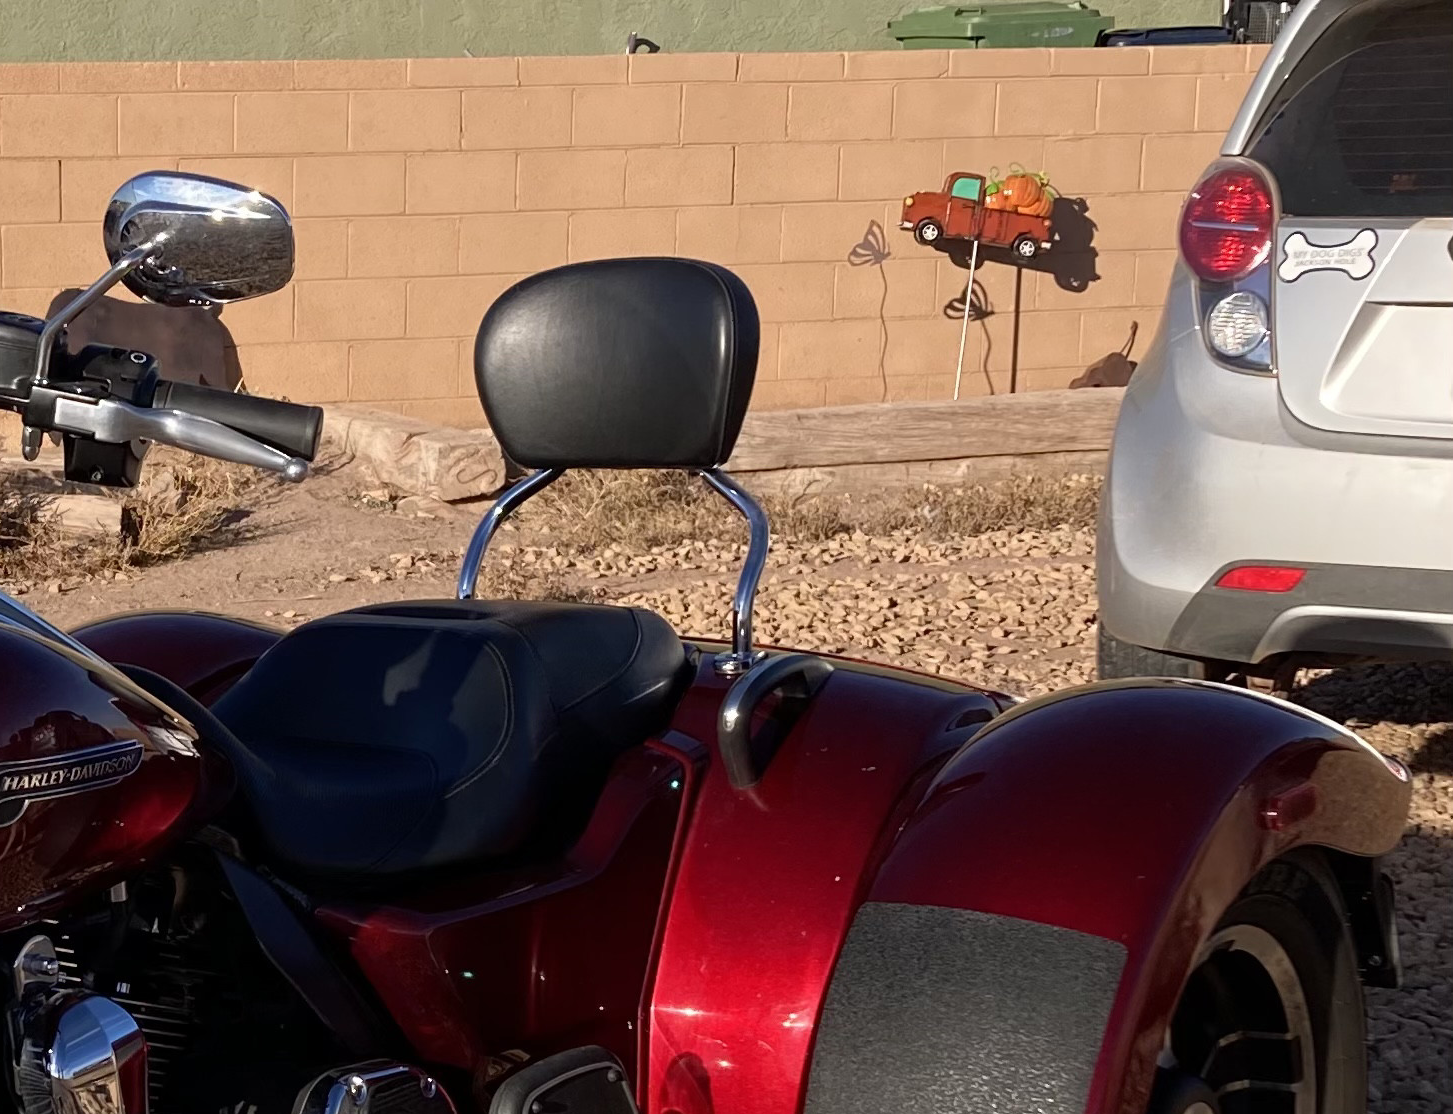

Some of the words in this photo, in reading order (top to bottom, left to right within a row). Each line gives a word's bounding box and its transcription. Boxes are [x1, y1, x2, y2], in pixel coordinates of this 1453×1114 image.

[1310, 249, 1334, 258] DOG
[1338, 247, 1365, 257] DIGS
[2, 753, 137, 792] HARLEY-DAVIDSON
